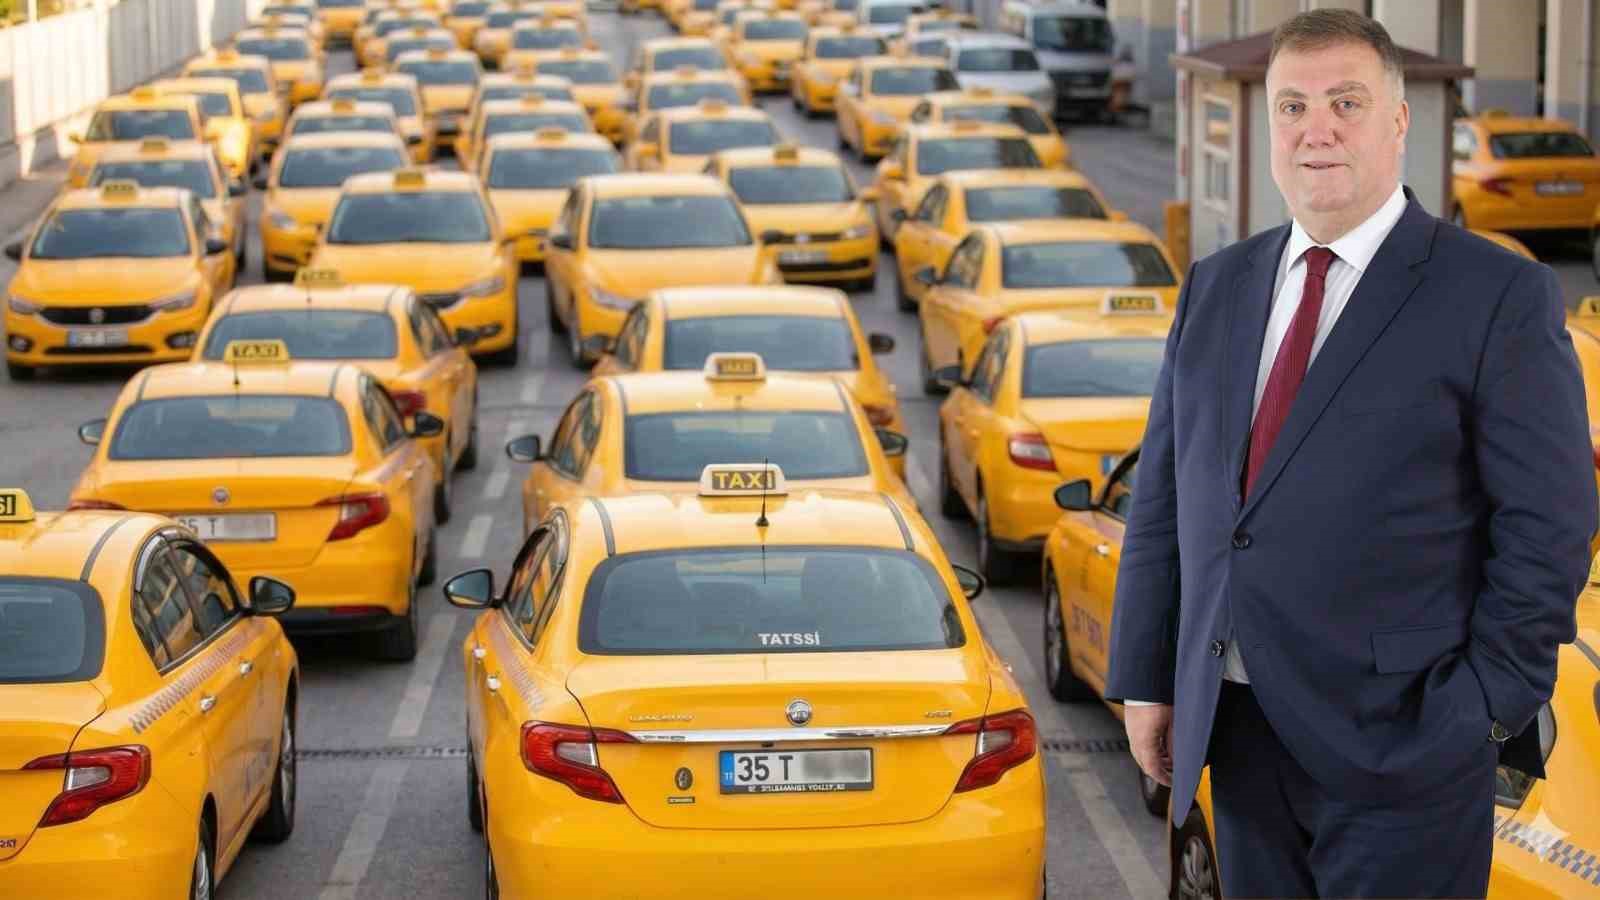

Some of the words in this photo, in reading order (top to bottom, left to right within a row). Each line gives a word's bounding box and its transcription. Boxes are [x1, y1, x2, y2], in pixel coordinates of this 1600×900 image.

[714, 471, 774, 489] TAXI
[738, 756, 770, 782] 35
[779, 755, 793, 781] T
